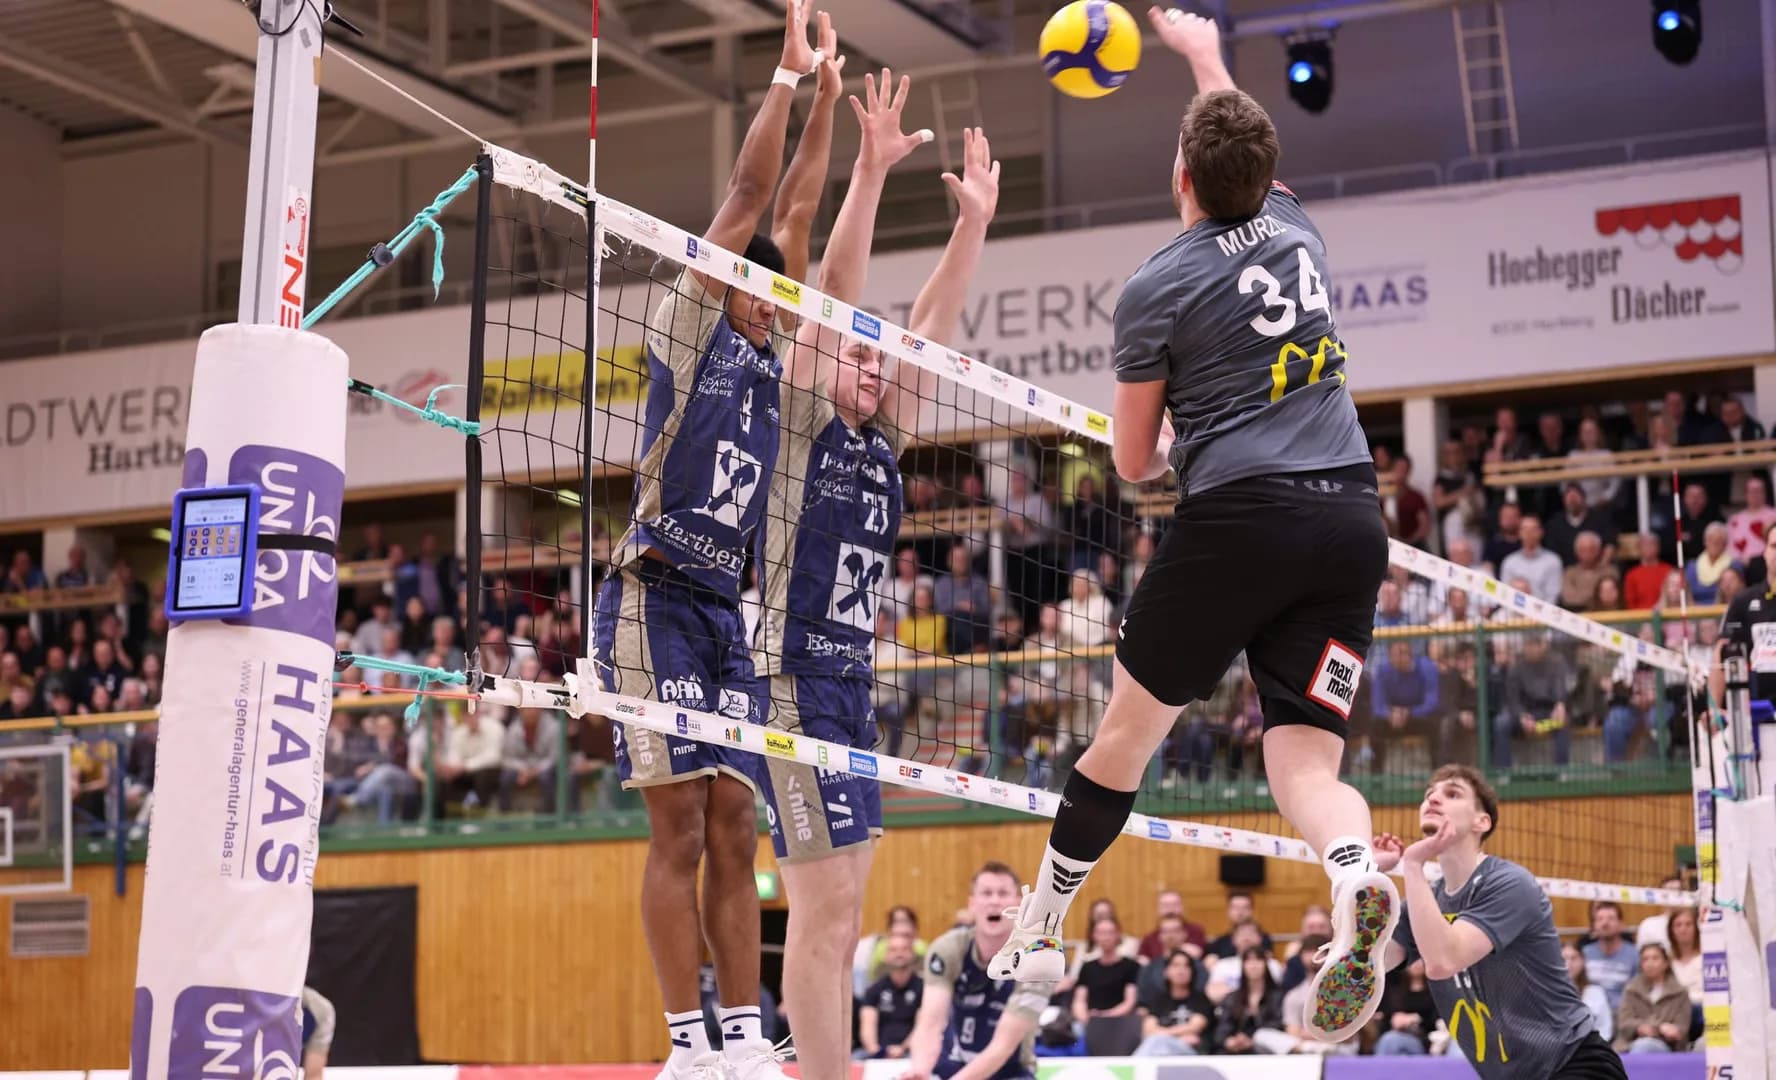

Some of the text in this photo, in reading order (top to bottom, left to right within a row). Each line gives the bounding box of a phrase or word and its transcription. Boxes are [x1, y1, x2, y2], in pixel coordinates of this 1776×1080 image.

[1238, 248, 1332, 337] 34
[1488, 246, 1622, 291] Hochegger
[1611, 279, 1706, 324] Dächer
[3, 385, 190, 447] DTWER
[251, 461, 299, 611] UNQA
[1326, 658, 1353, 685] maxi
[256, 663, 318, 884] HAAS
[673, 744, 697, 756] nine
[831, 817, 854, 831] nine
[201, 1002, 244, 1080] UN
